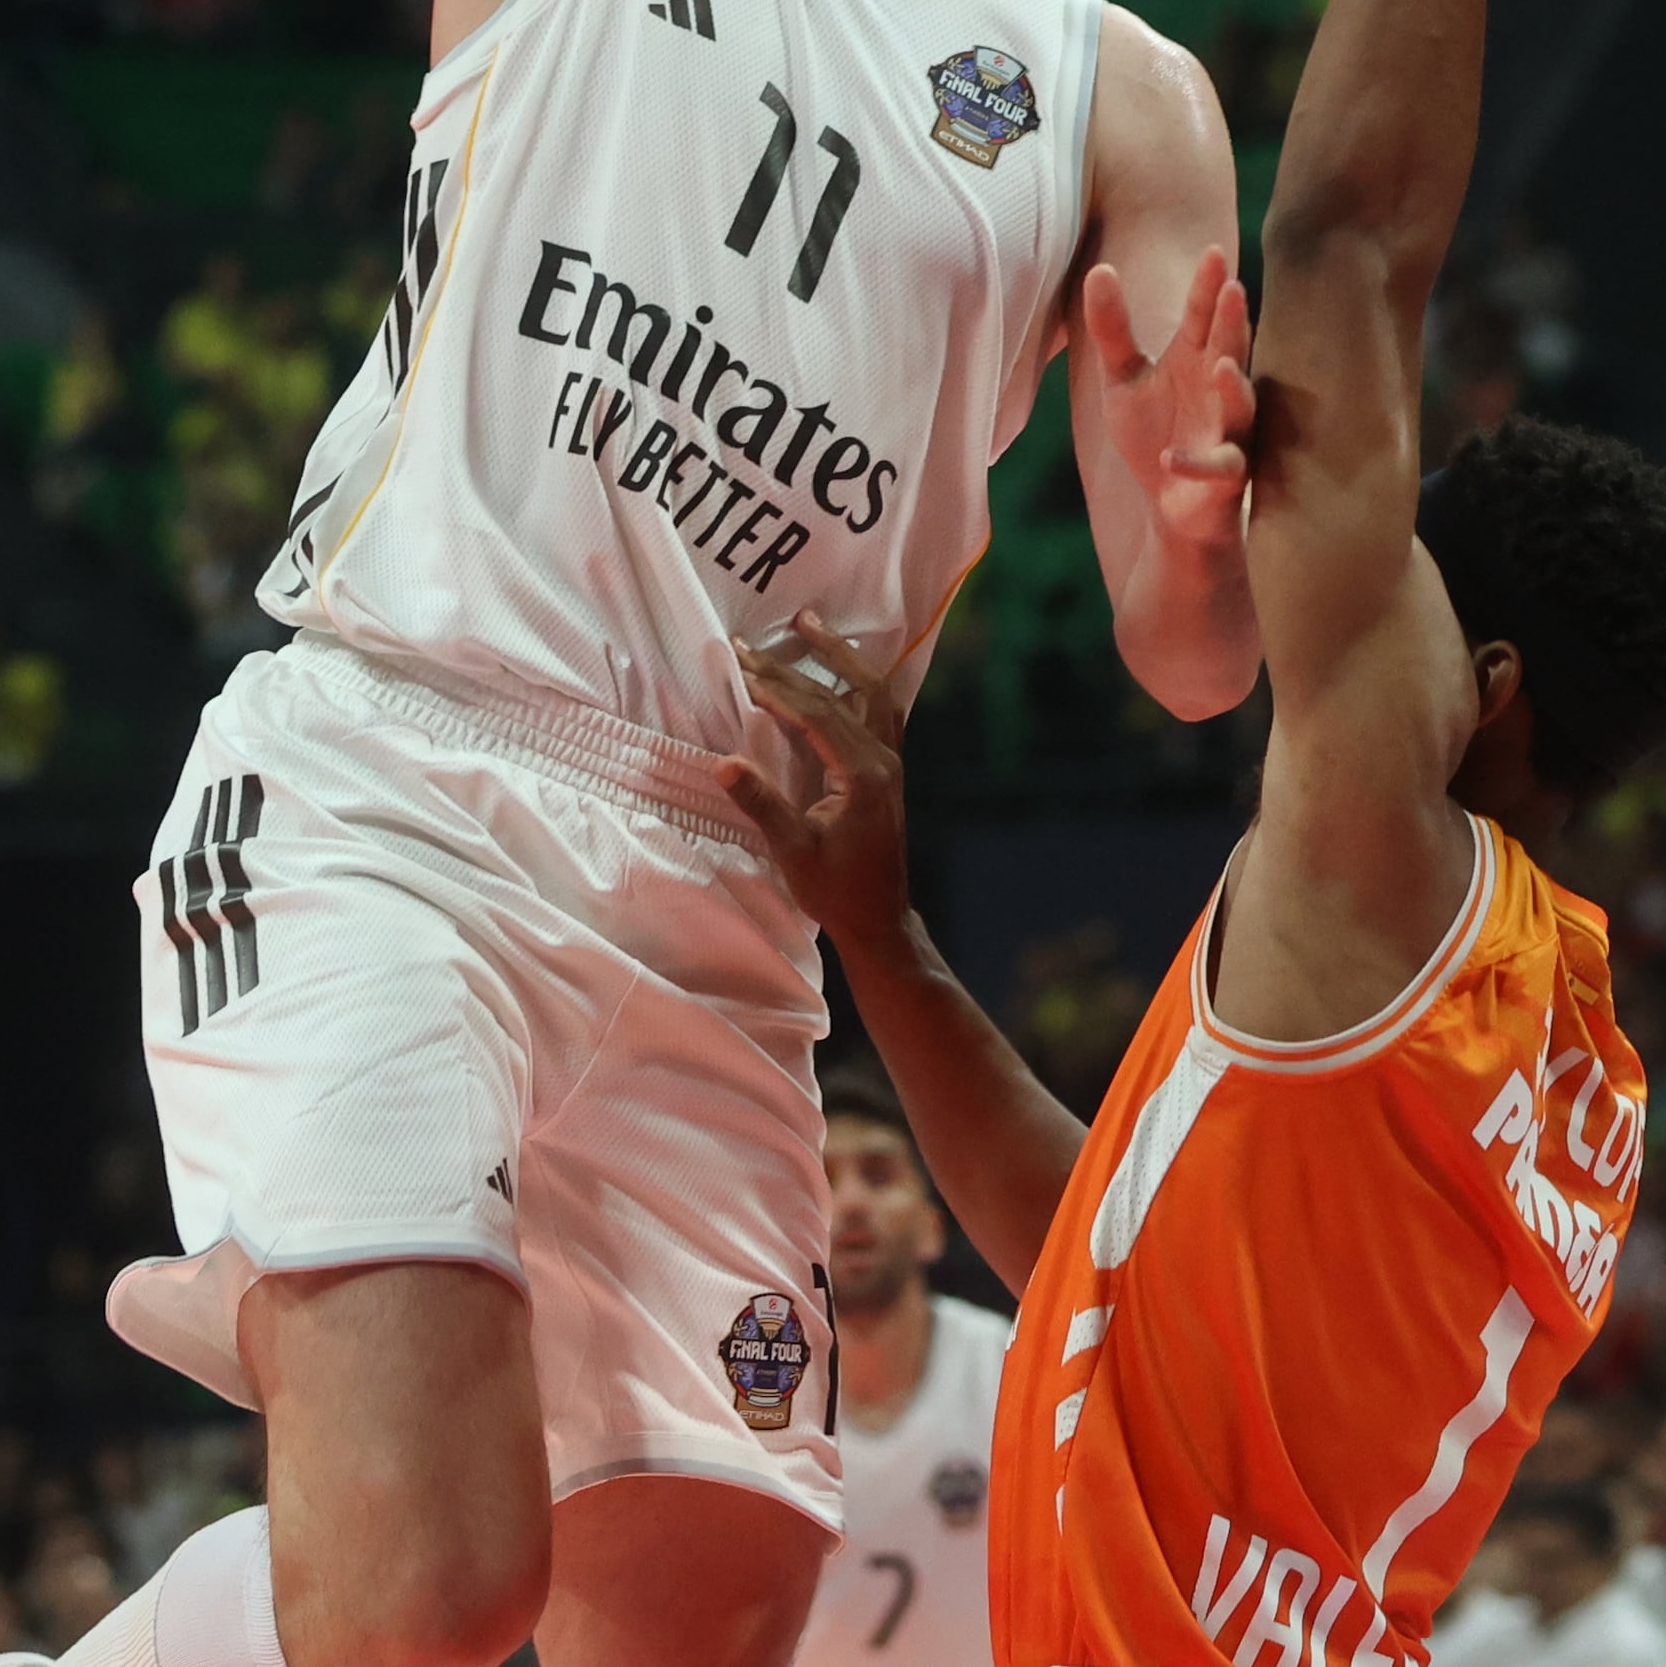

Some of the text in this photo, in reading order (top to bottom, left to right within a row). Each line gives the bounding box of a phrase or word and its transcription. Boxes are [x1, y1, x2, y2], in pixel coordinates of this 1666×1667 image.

[724, 80, 861, 304] 11
[984, 93, 1029, 127] FOUR
[518, 239, 898, 534] Emirates
[548, 372, 811, 594] FLY BETTER
[770, 1342, 802, 1363] FOUR
